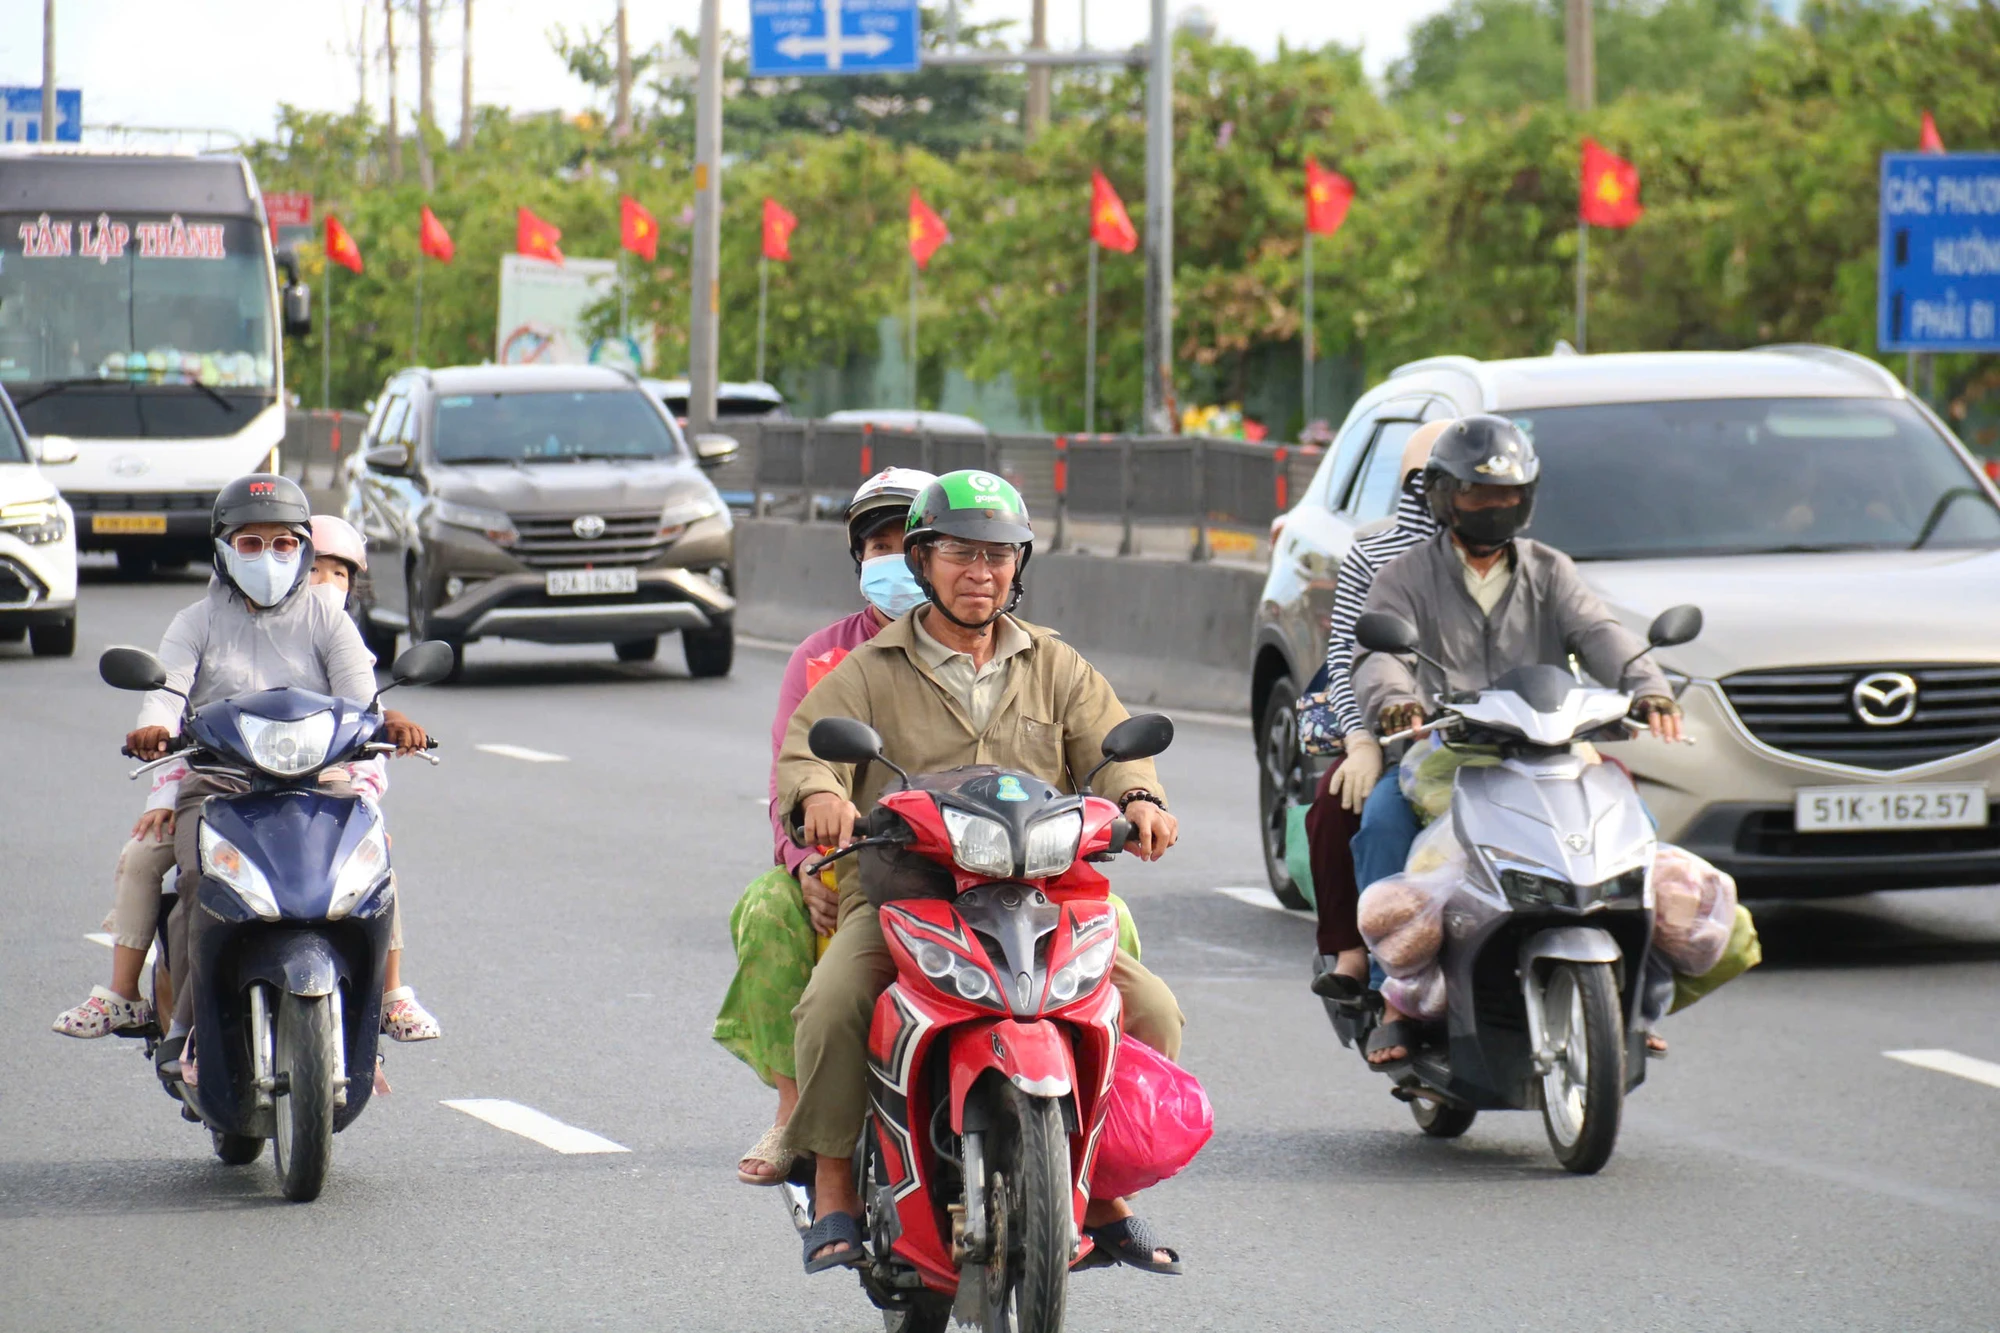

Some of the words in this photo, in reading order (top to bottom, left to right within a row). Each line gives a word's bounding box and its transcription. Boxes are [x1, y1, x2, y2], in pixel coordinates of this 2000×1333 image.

[18, 212, 72, 257] TÂN
[79, 212, 129, 265] LẬP
[135, 212, 226, 259] THÀNH
[974, 495, 1001, 503] goj
[1076, 914, 1109, 933] Jupi
